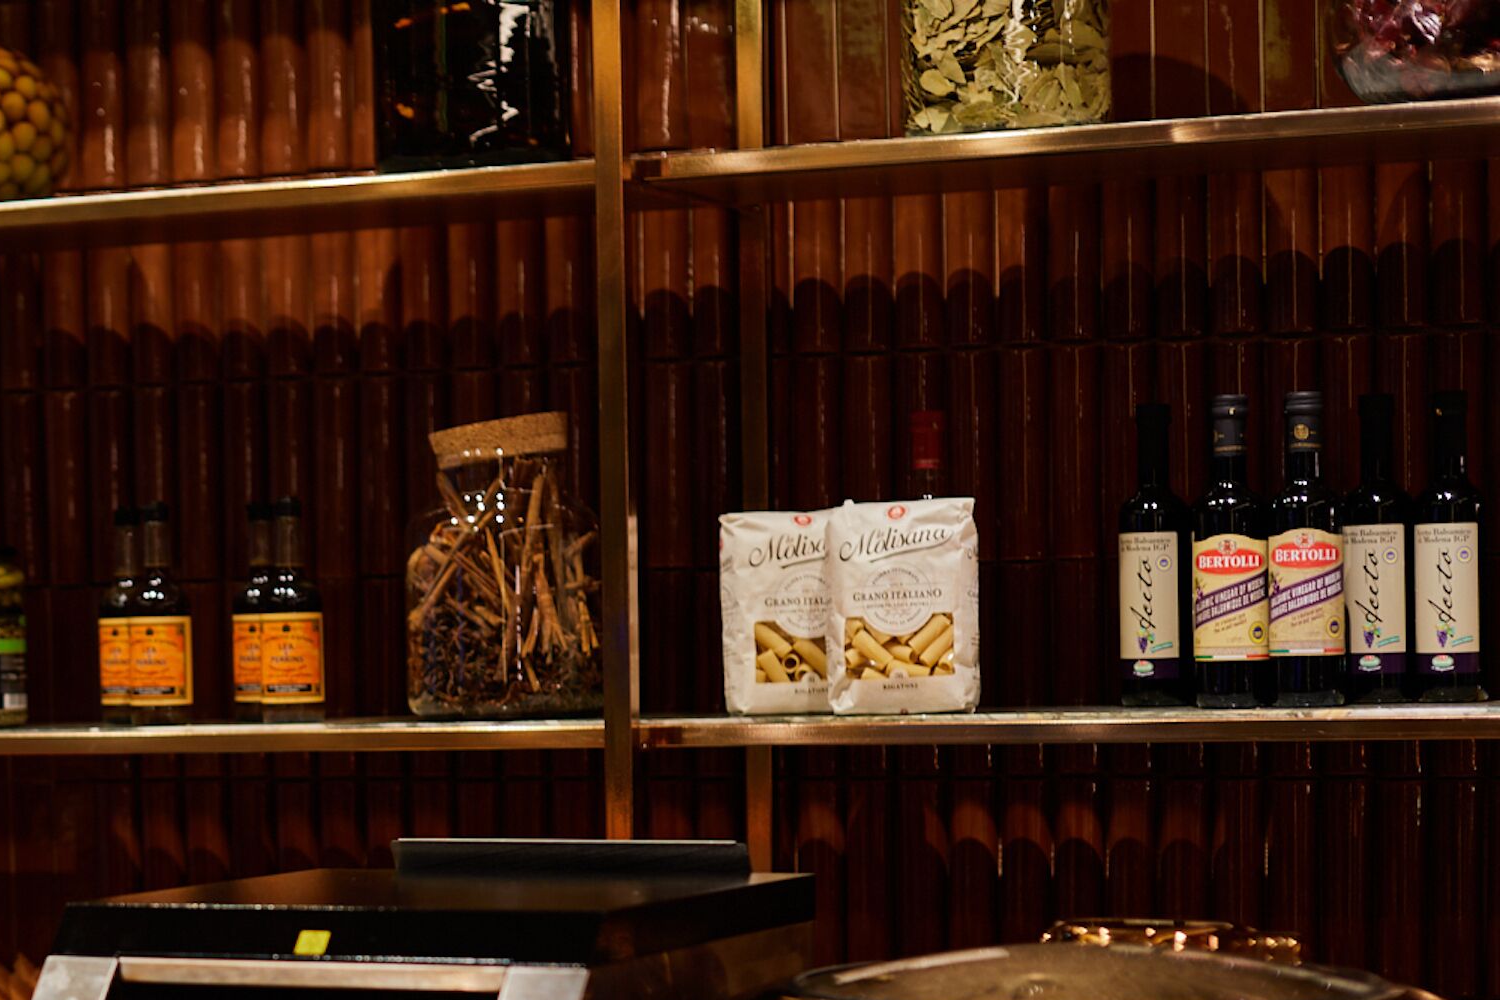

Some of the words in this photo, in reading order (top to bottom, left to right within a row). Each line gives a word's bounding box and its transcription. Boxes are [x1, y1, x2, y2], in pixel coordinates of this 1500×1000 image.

[749, 534, 826, 567] Molisa
[840, 527, 947, 561] Molisana
[1198, 554, 1260, 569] BERTOLLI
[1275, 547, 1337, 563] BERTOLLI
[853, 590, 889, 601] GRANO
[891, 588, 942, 600] ITALIANO
[764, 597, 801, 608] GRANO
